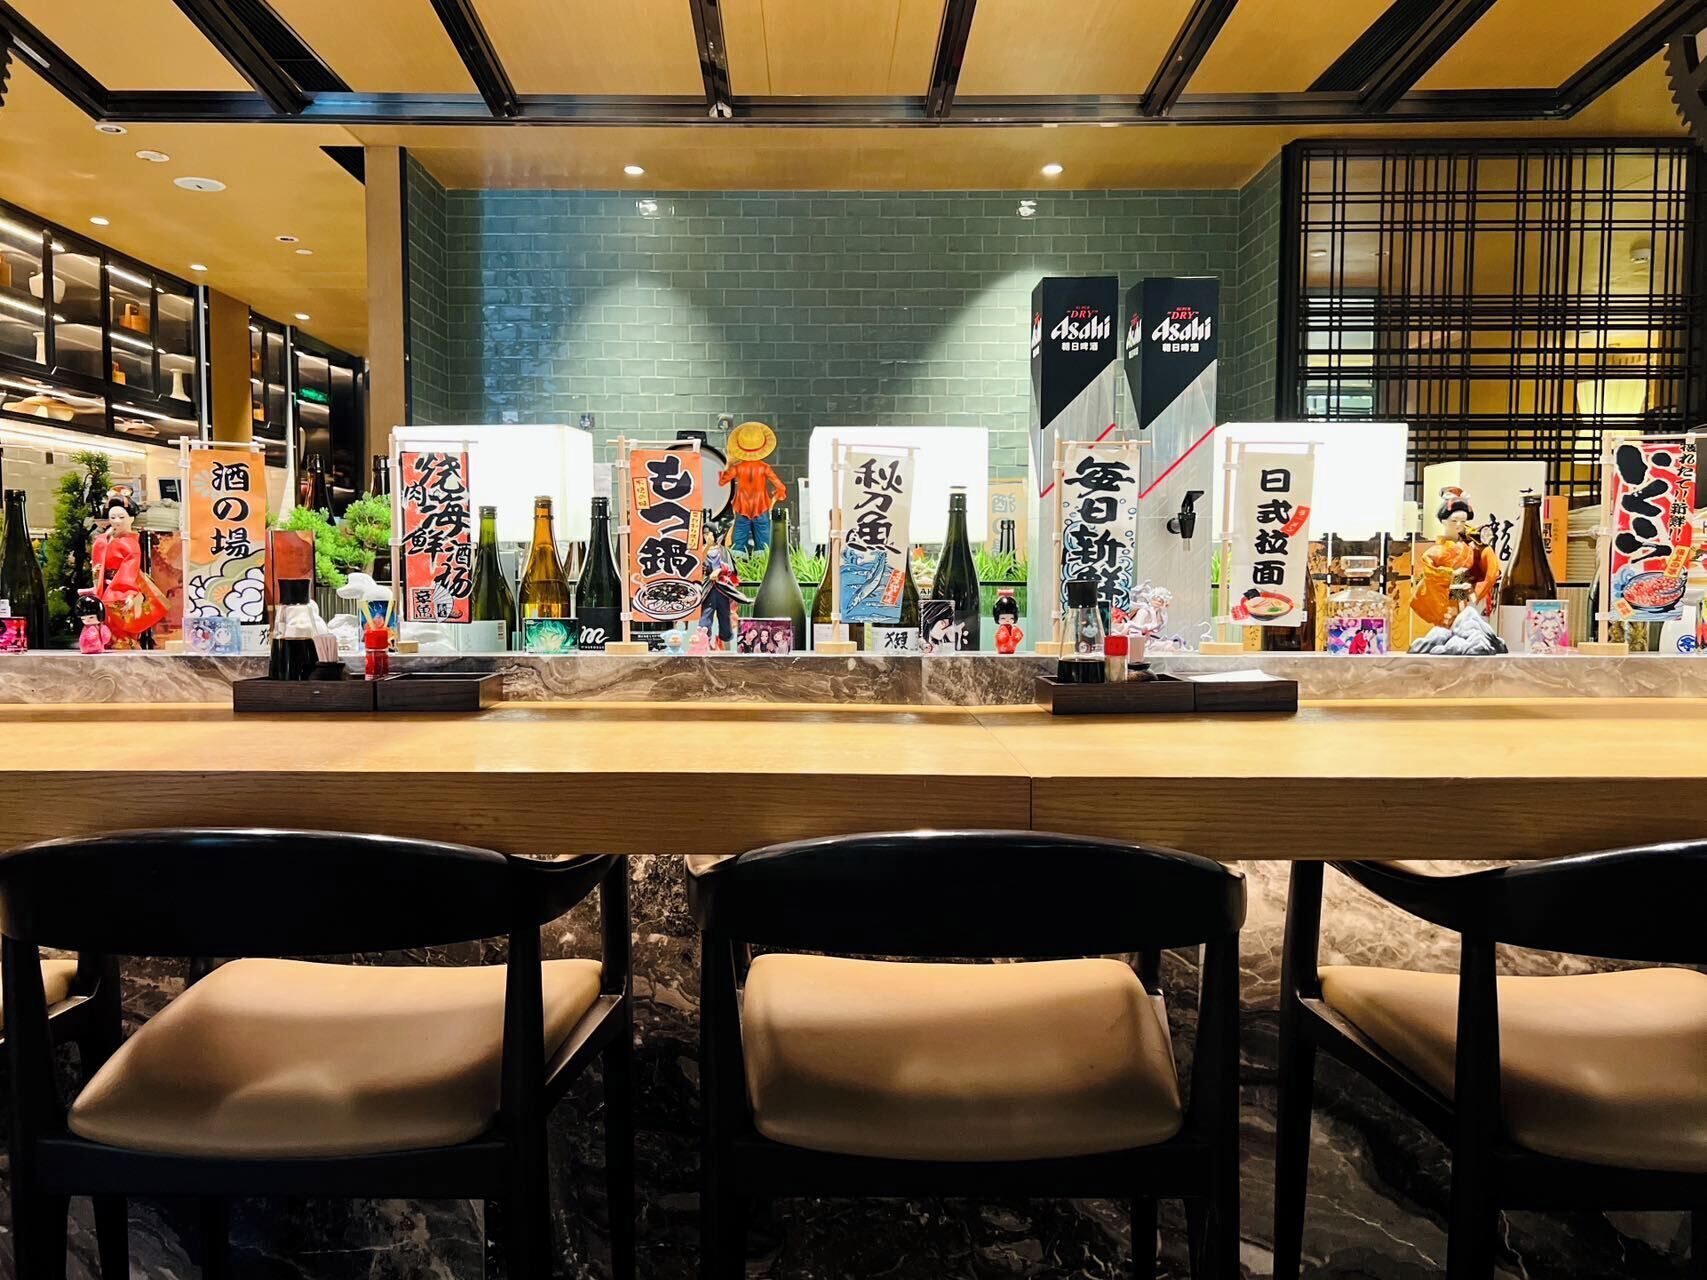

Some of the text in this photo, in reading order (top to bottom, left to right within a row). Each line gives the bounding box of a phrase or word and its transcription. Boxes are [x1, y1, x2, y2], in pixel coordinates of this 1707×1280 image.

[1051, 315, 1110, 340] Asahi
[1152, 316, 1211, 341] Asahi
[210, 461, 251, 558] 酒の場
[1252, 468, 1293, 586] 日式拉面
